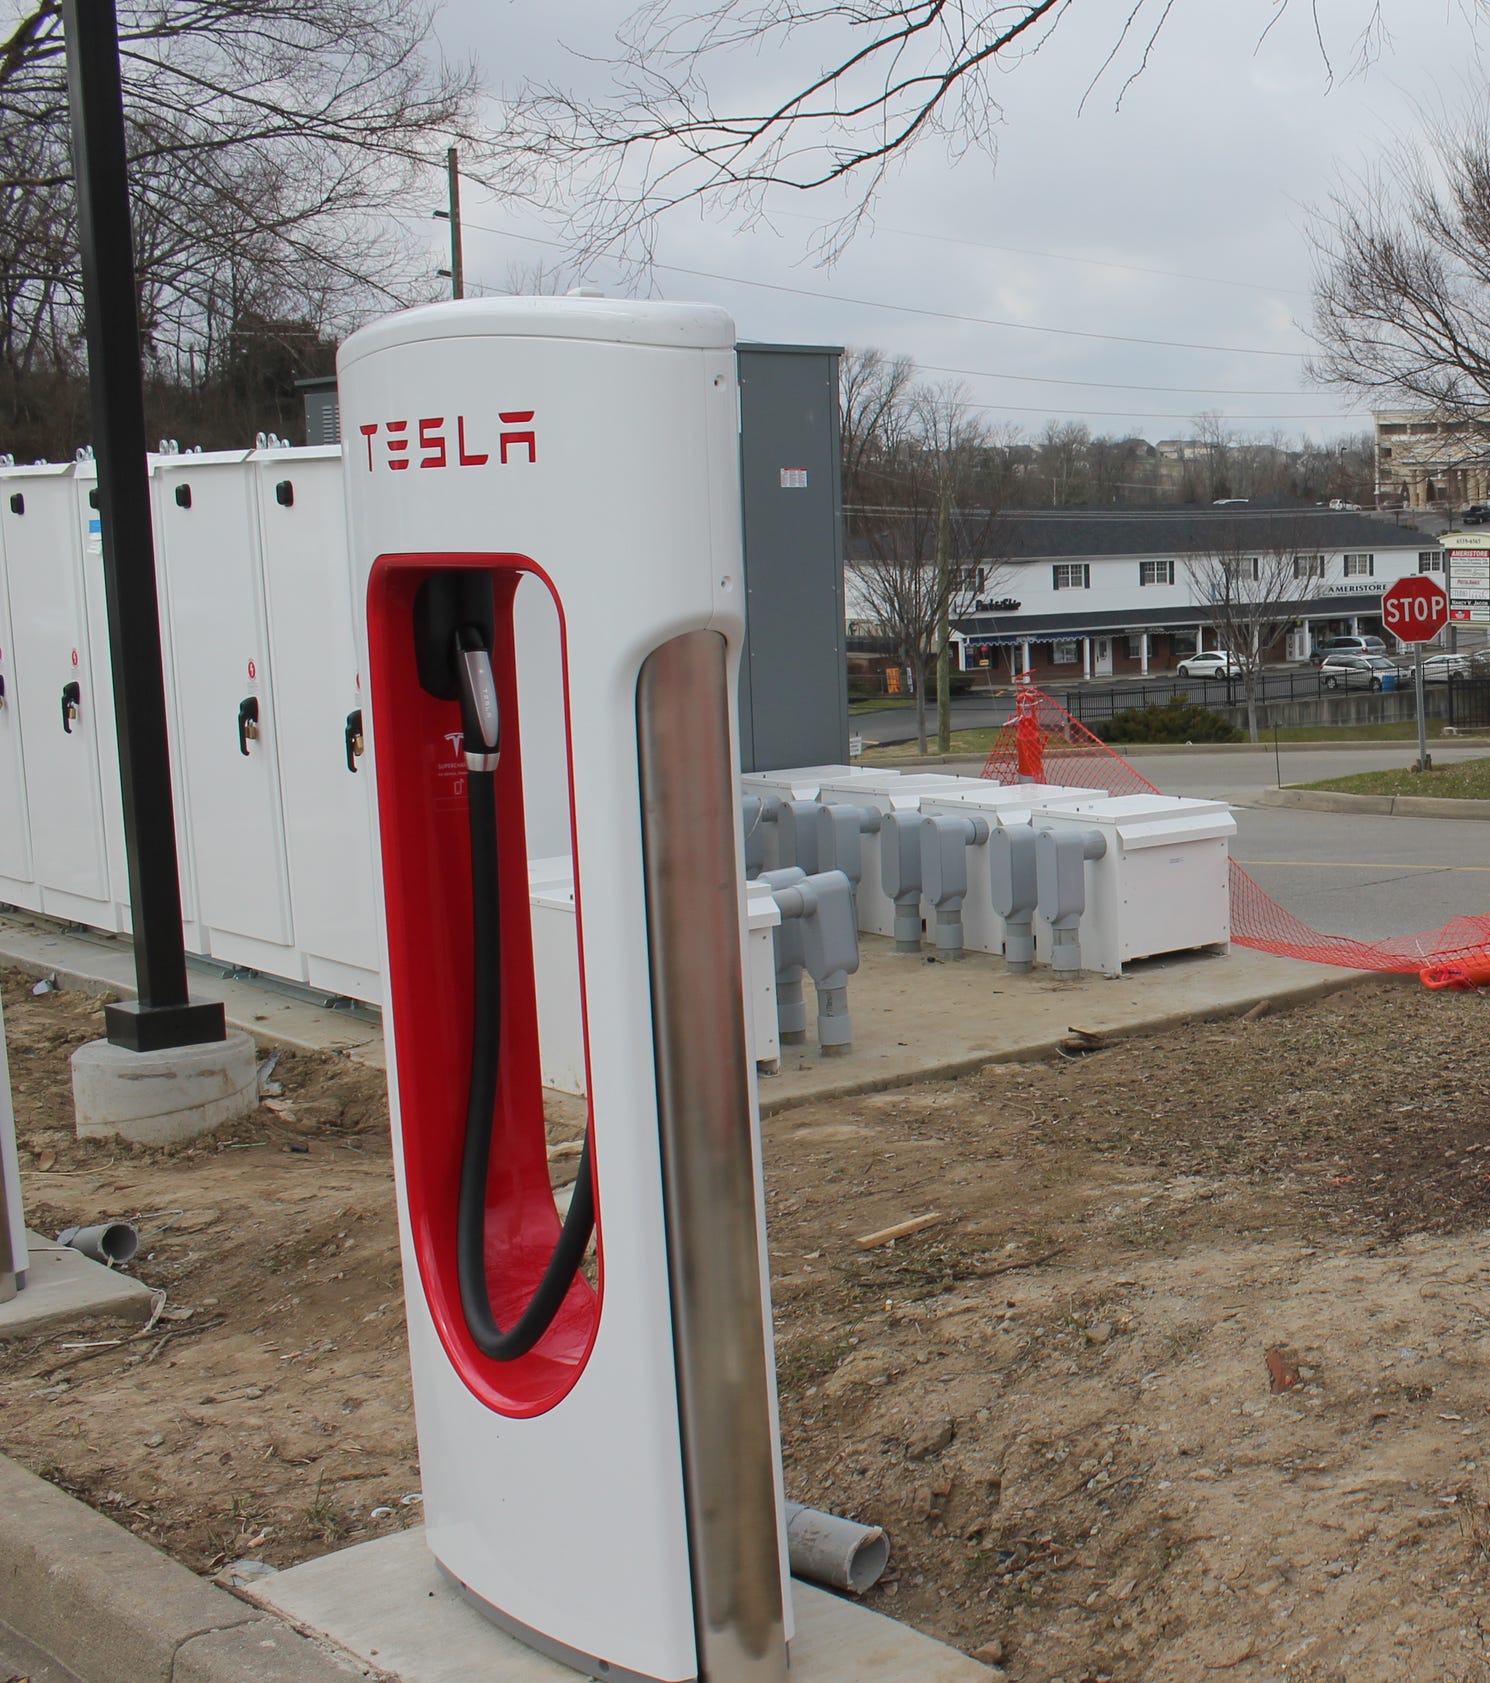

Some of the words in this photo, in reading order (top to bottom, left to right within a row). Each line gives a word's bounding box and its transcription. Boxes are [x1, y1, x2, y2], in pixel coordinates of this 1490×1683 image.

[359, 411, 536, 472] TESLA
[1328, 583, 1387, 594] AMERISTORE
[1386, 596, 1445, 623] STOP
